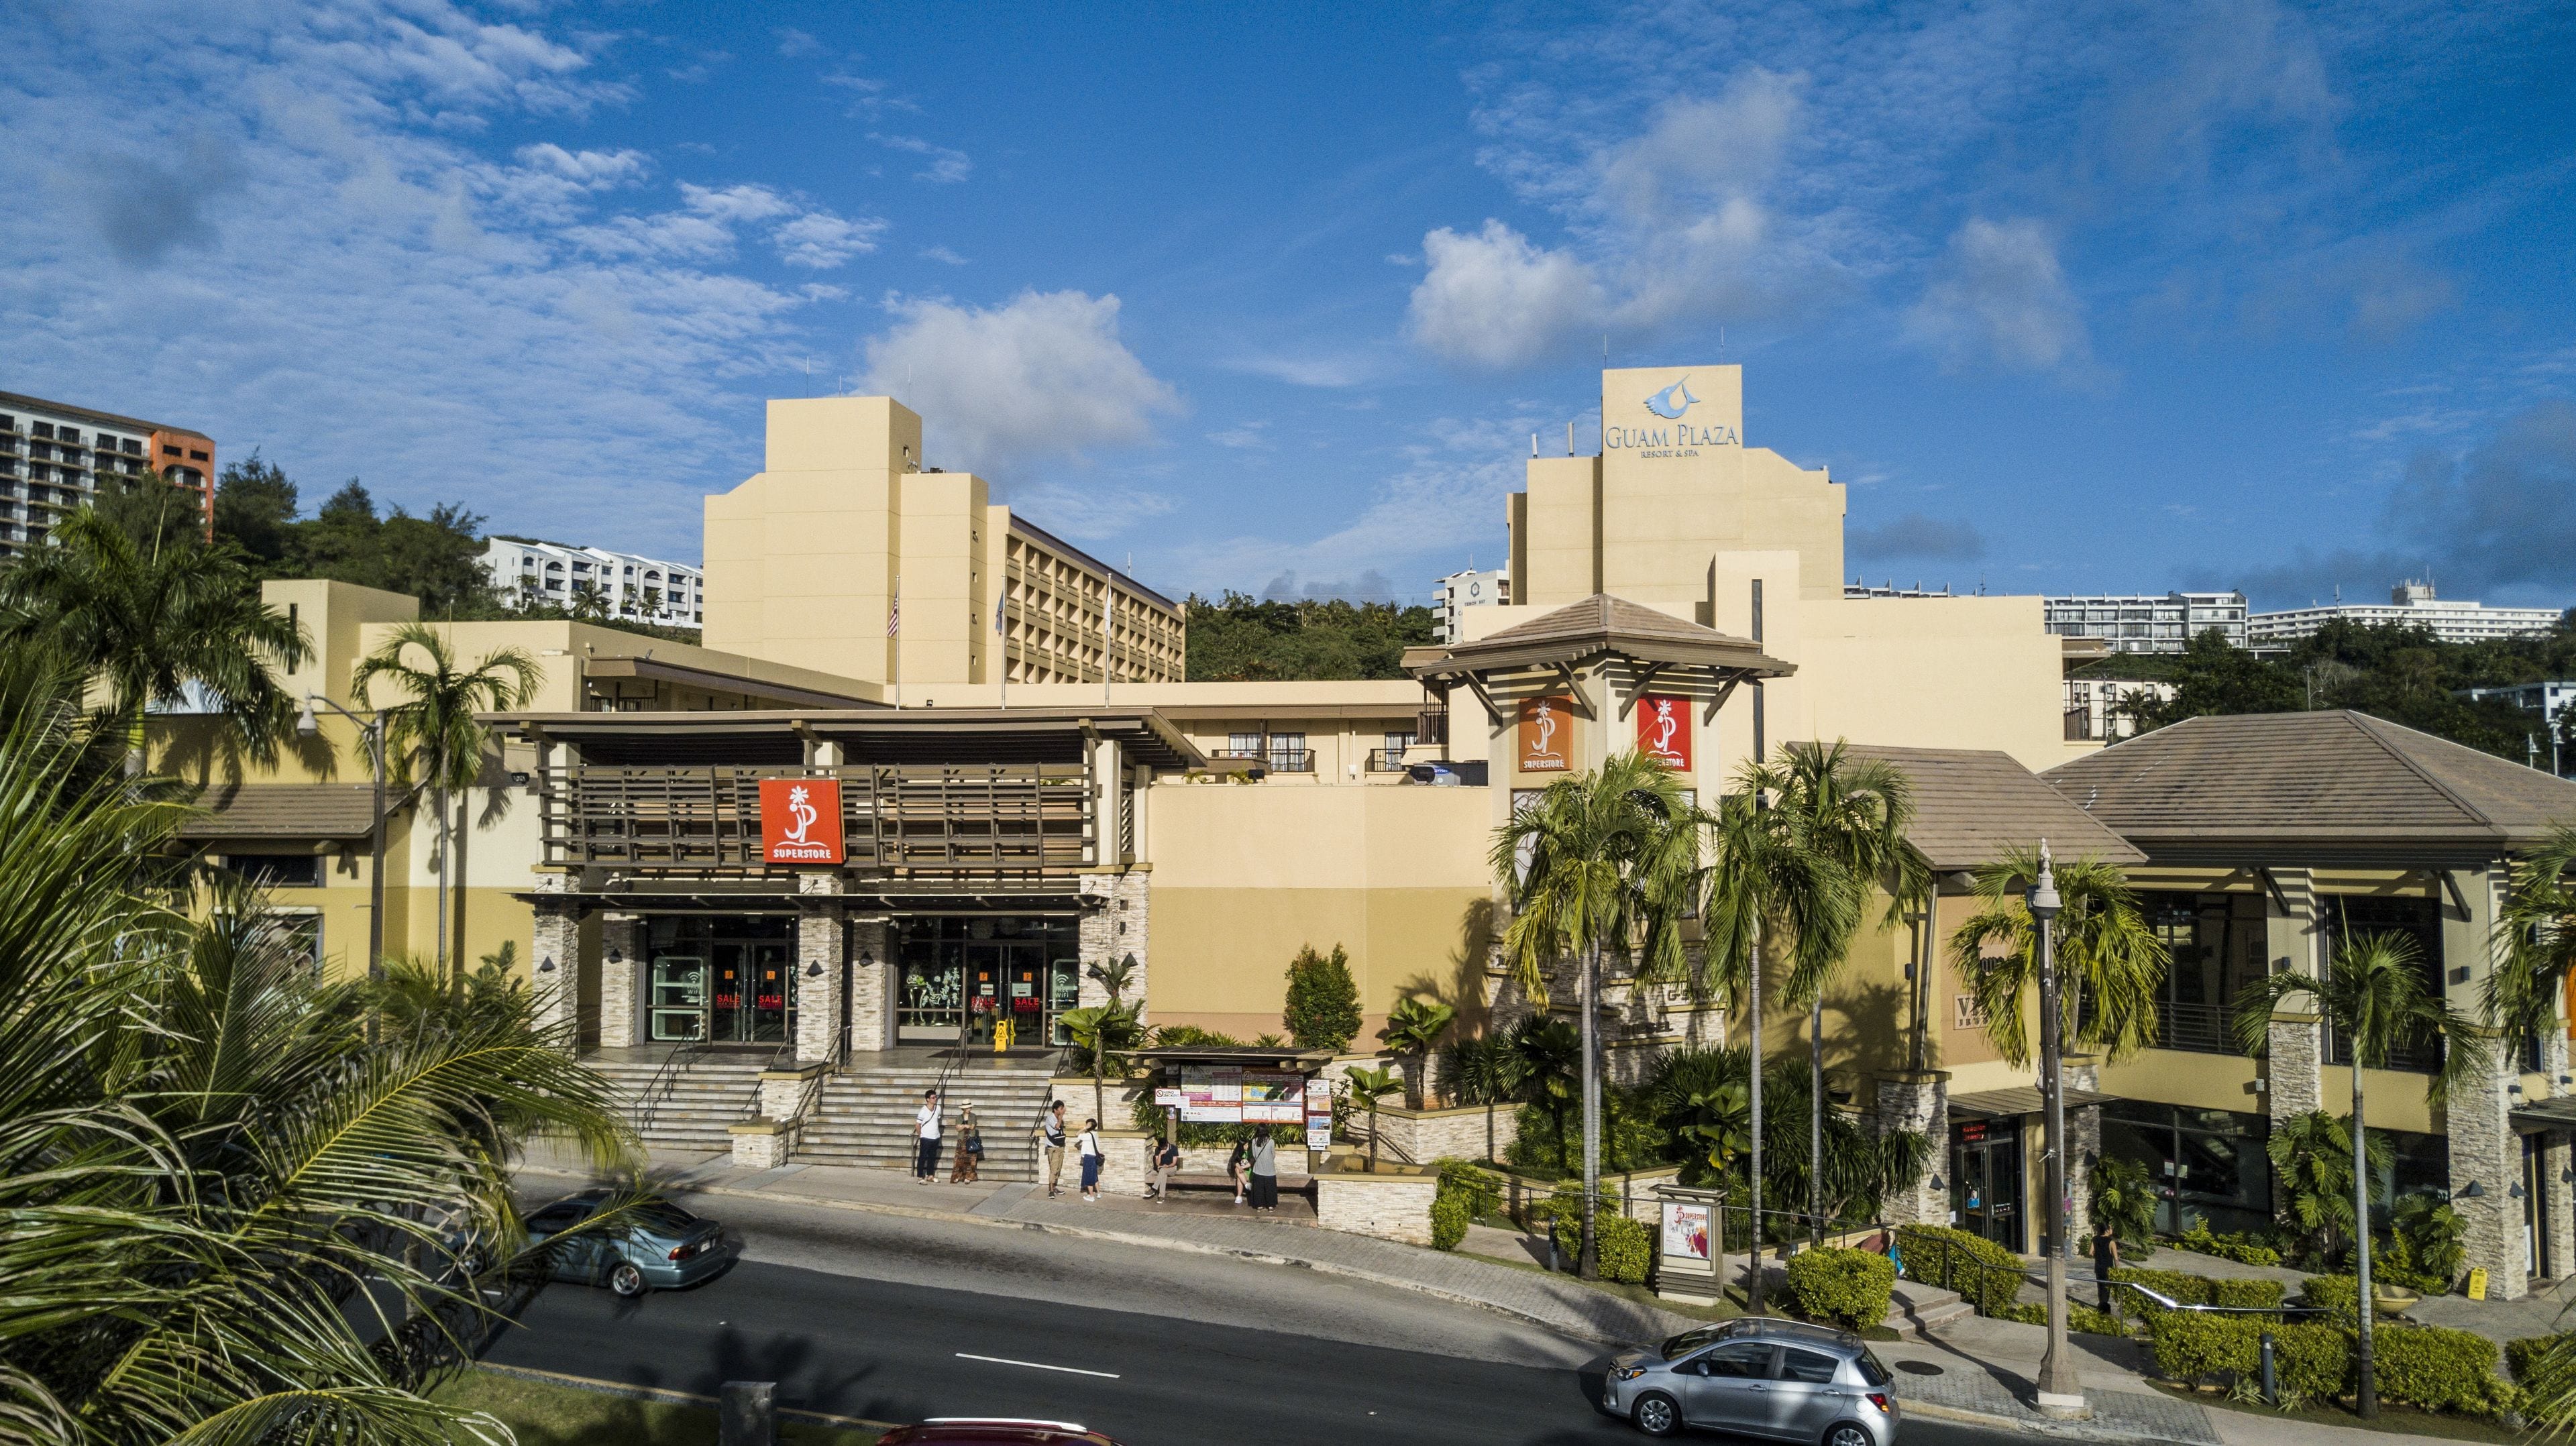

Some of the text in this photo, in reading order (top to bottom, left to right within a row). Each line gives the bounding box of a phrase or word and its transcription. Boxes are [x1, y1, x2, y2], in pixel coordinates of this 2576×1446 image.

[1605, 424, 1739, 449] GUAM PLAZA
[1641, 450, 1673, 458] RESORT
[1523, 759, 1564, 769] SUPERSTORE
[773, 848, 831, 858] SUPERSTORE
[716, 995, 741, 1003] SALE
[758, 995, 782, 1003] SALE
[1015, 997, 1039, 1005] SALE
